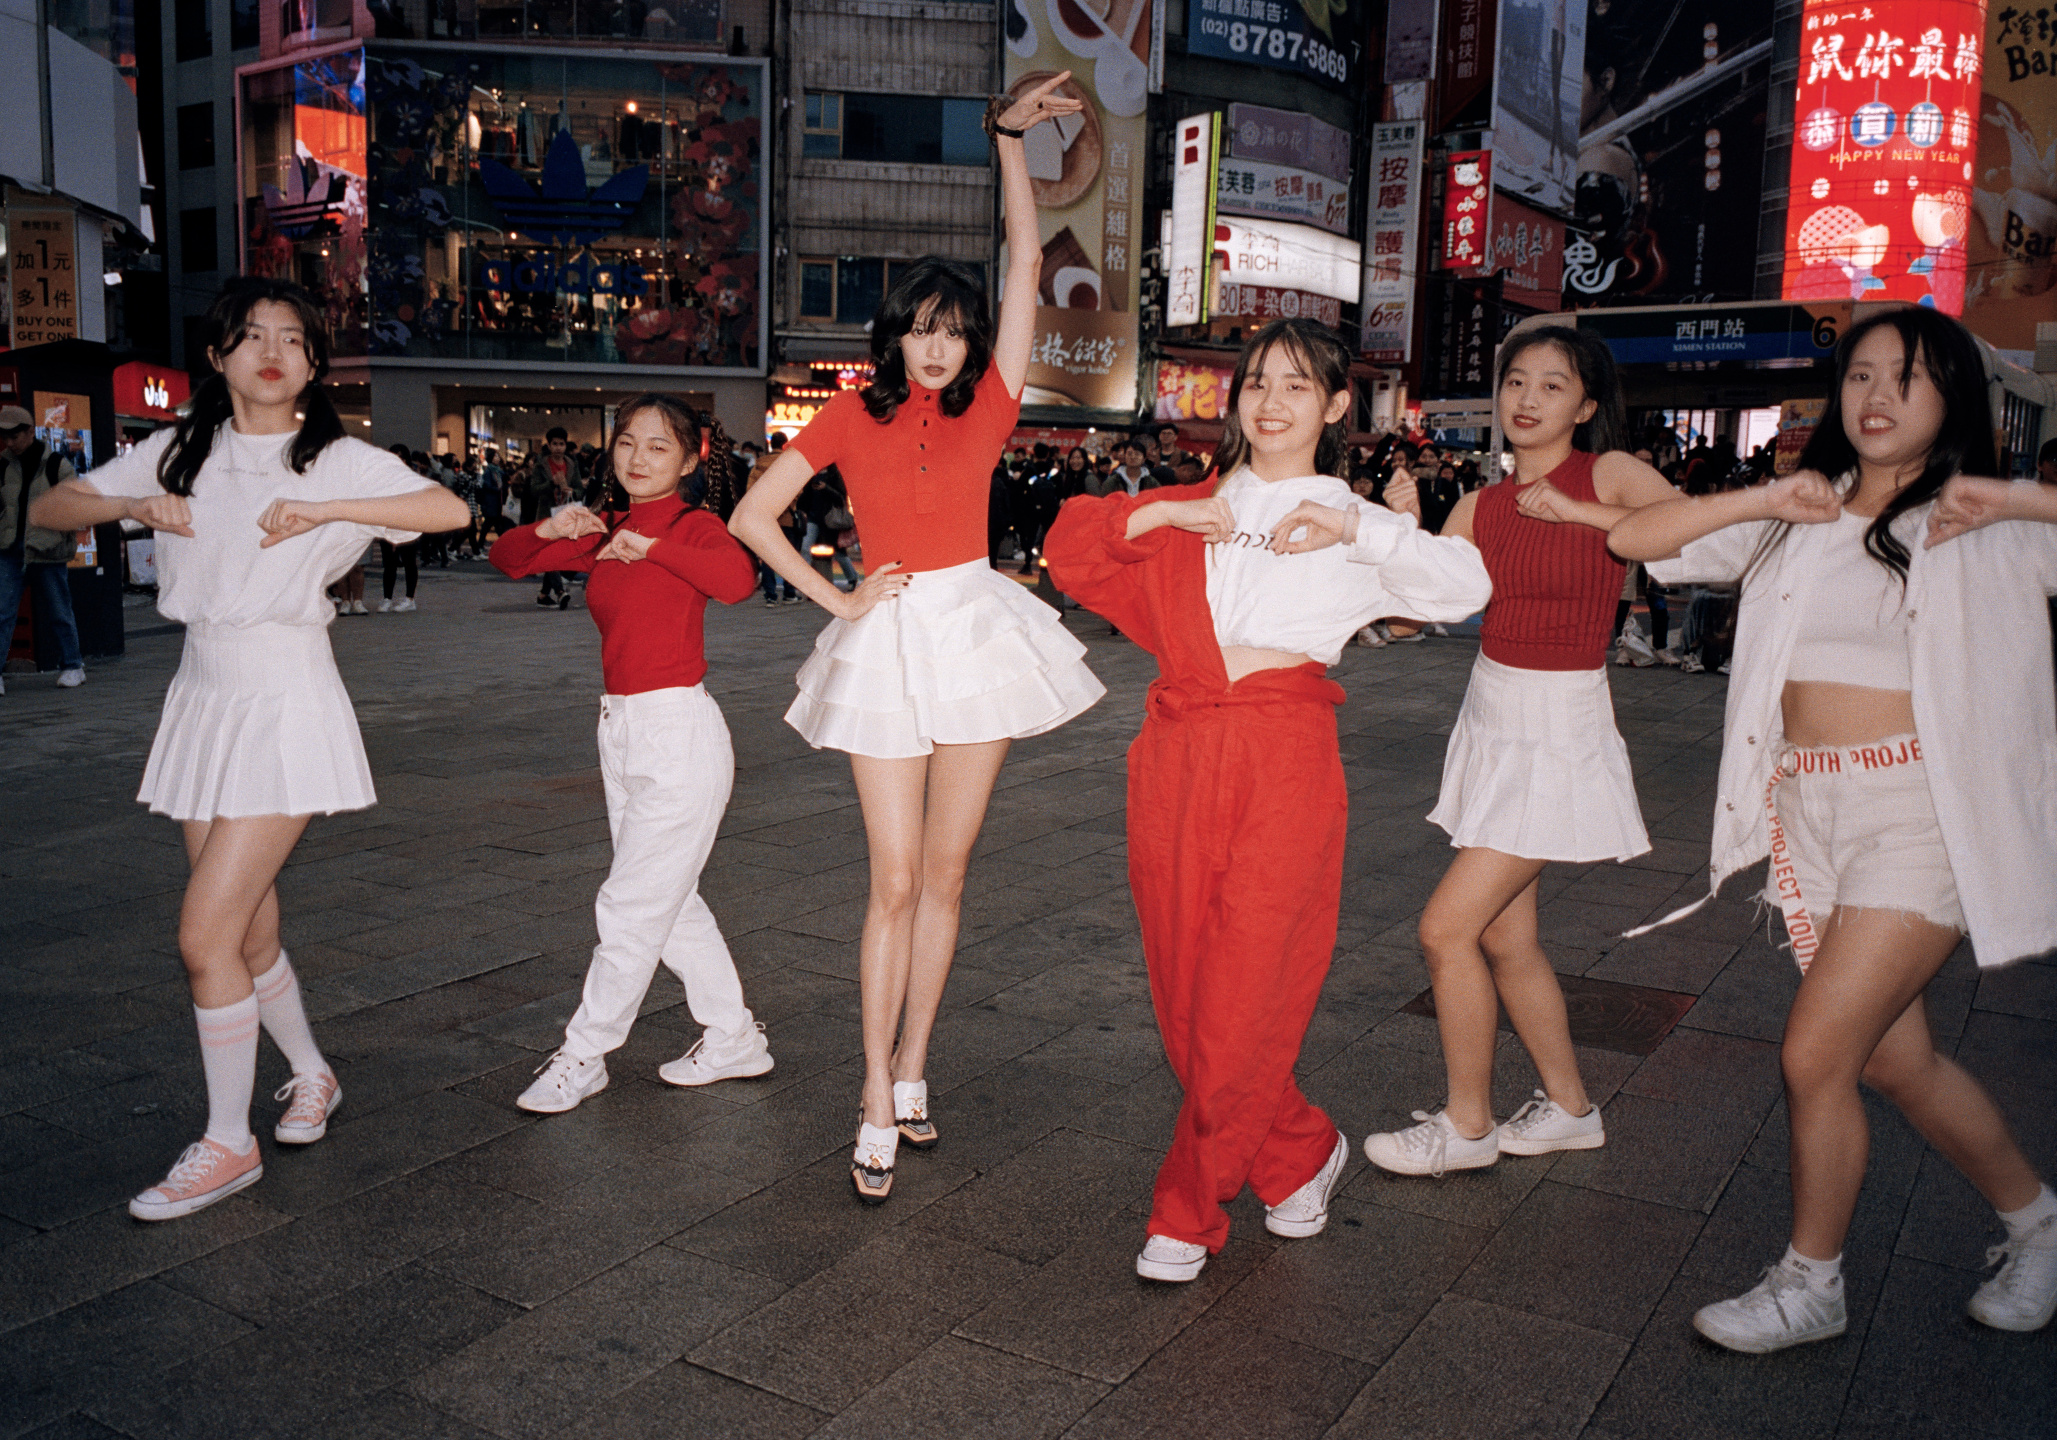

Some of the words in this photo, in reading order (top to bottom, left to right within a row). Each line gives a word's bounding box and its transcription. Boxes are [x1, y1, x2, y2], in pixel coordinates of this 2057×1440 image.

[1806, 28, 1980, 84] 鼠你最棒
[1830, 150, 1883, 164] HAPPY
[1892, 150, 1925, 161] NEW
[1931, 152, 1960, 164] YEAR
[1238, 252, 1279, 273] RICH
[480, 250, 649, 297] adidas
[16, 316, 42, 327] BUY
[46, 317, 74, 327] ONE
[1676, 318, 1745, 340] 西門站
[17, 331, 43, 341] GET
[46, 332, 74, 341] ONE
[1813, 316, 1837, 349] 6
[1705, 341, 1746, 350] STATION
[1769, 814, 1802, 901] PROJECT
